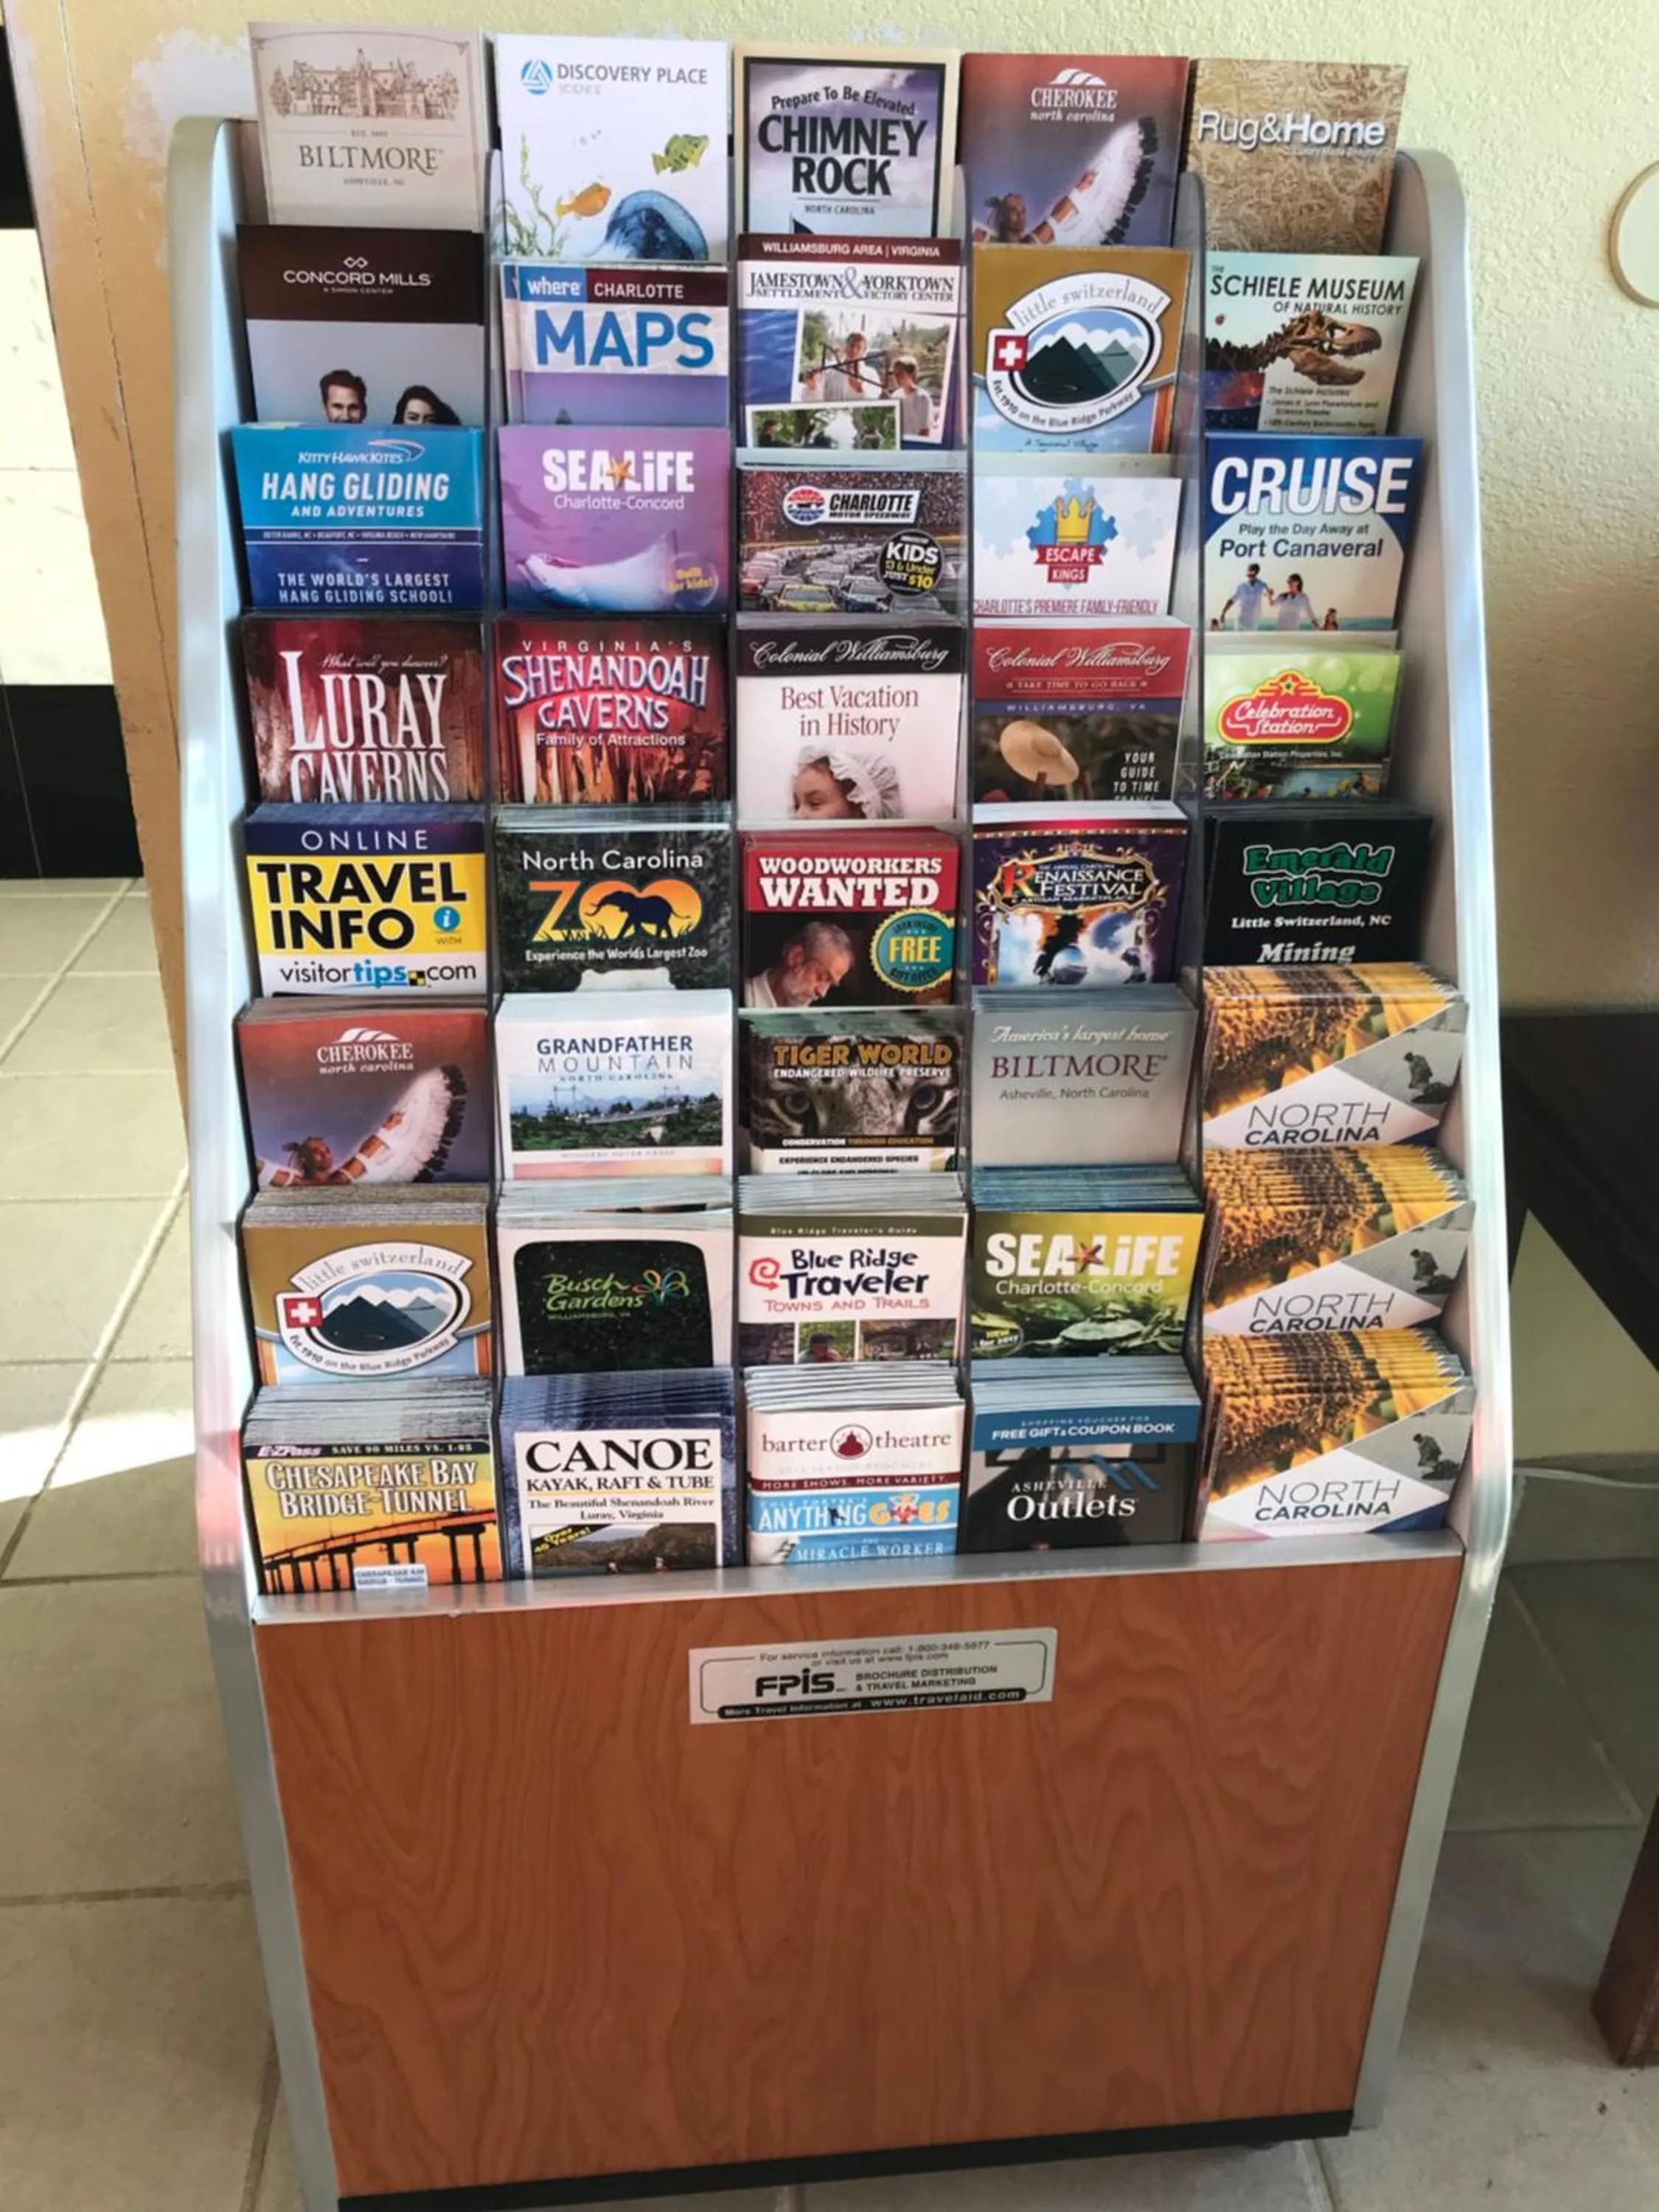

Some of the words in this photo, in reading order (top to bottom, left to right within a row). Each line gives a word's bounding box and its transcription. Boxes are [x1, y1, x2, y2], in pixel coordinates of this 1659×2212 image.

[557, 63, 651, 81] DISCOVERY
[657, 66, 708, 84] PLACE
[771, 91, 820, 110] Prepare
[823, 86, 838, 100] To
[843, 87, 860, 101] Be
[863, 90, 916, 115] Elevated
[1031, 88, 1118, 108] CHEROKEE
[758, 114, 928, 157] CHIMNEY
[299, 145, 439, 175] BILTMORE
[792, 156, 891, 195] ROCK
[762, 242, 849, 255] WILLIAMSBURG
[852, 243, 883, 256] AREA
[891, 245, 941, 257] VIRGINIA
[283, 270, 375, 285] CONCORD
[379, 272, 431, 286] MILLS
[526, 276, 580, 295] where
[594, 282, 684, 298] CHARLOTTE
[1210, 274, 1302, 298] SCHIELE
[1307, 278, 1405, 301] MUSEUM
[1273, 301, 1291, 313] OF
[1294, 302, 1348, 314] NATURAL
[1352, 304, 1405, 316] HISTORY
[535, 308, 714, 369] MAPS
[262, 472, 335, 501] HANG
[343, 472, 450, 501] GLIDING
[1211, 456, 1413, 515] CRUISE
[291, 505, 321, 517] AND
[326, 505, 425, 517] ADVENTURES
[830, 493, 914, 511] CHARLOTTE
[1238, 524, 1264, 536] Play
[1268, 524, 1289, 535] the
[1293, 524, 1317, 537] Day
[1319, 524, 1352, 537] Away
[1356, 524, 1369, 535] at
[886, 542, 939, 565] KIDS
[1045, 547, 1096, 563] ESCAPE
[1220, 539, 1267, 557] Port
[1272, 538, 1383, 557] Canaveral
[278, 573, 305, 586] THE
[310, 573, 379, 587] WORLD'S
[384, 574, 450, 587] LARGEST
[1052, 568, 1086, 581] KINGS
[279, 590, 319, 603] HANG
[325, 590, 384, 603] GLIDING
[390, 590, 453, 603] SCHOOL!
[502, 655, 709, 706] SHENANDOAH
[279, 651, 448, 751] LURAY
[782, 686, 824, 709] Best
[830, 685, 919, 708] Vacation
[538, 693, 669, 729] CAVERNS
[1234, 700, 1335, 720] Celebration
[799, 714, 820, 737] in
[828, 713, 900, 742] History
[537, 733, 584, 747] Family
[589, 734, 603, 745] of
[607, 734, 686, 745] Attractions
[1124, 751, 1155, 764] YOUR
[1120, 767, 1155, 778] GUIDE
[1113, 781, 1128, 792] TO
[1132, 781, 1160, 793] TIME
[301, 830, 429, 850] ONLINE
[523, 849, 594, 871] North
[602, 849, 703, 869] Carolina
[759, 858, 942, 874] WOODWORKERS
[1243, 842, 1395, 877] Emerald
[256, 862, 467, 903] TRAVEL
[759, 877, 940, 907] WANTED
[1040, 883, 1141, 897] FESTIVAL
[1251, 875, 1382, 908] Village
[271, 908, 414, 950] INFO
[1231, 917, 1270, 929] Little
[1274, 915, 1365, 928] Switzerland,
[1368, 915, 1392, 926] NC
[435, 936, 462, 945] WITH
[888, 936, 942, 964] FREE
[525, 950, 585, 963] Experience
[588, 949, 605, 959] the
[647, 947, 686, 961] Largest
[688, 946, 708, 958] Zoo
[1256, 942, 1356, 963] Mining
[316, 1043, 414, 1063] CHEROKEE
[537, 1035, 693, 1054] GRANDFATHER
[773, 1044, 849, 1066] TIGER
[858, 1043, 953, 1066] WORLD
[319, 1062, 356, 1074] north
[360, 1061, 414, 1073] carolina
[538, 1054, 693, 1074] MOUNTAIN
[774, 1068, 844, 1078] ENDANGERED
[849, 1068, 894, 1078] WILDLIFE
[899, 1068, 951, 1077] PRESERVE
[991, 1054, 1162, 1082] BILTMORE
[999, 1089, 1056, 1100] Asheville,
[1060, 1088, 1096, 1099] North
[1099, 1087, 1150, 1099] Carolina
[1248, 1102, 1391, 1130] NORTH
[1245, 1127, 1380, 1145] CAROLINA
[830, 1155, 883, 1164] ENDANGERED
[886, 1155, 919, 1163] SPECIES
[797, 1227, 827, 1236] Ridge
[832, 1226, 883, 1234] Traveler's
[888, 1226, 917, 1234] Guide
[790, 1248, 844, 1270] Blue
[849, 1248, 919, 1270] Ridge
[543, 1273, 631, 1294] Busch
[779, 1269, 930, 1299] Traveler
[546, 1291, 646, 1312] Gardens
[763, 1299, 823, 1313] TOWNS
[831, 1299, 866, 1310] AND
[872, 1296, 930, 1310] TRAILS
[1253, 1292, 1396, 1318] NORTH
[1248, 1315, 1384, 1334] CAROLINA
[762, 1433, 828, 1453] barter
[875, 1430, 952, 1450] theatre
[992, 1429, 1026, 1441] FREE
[1029, 1427, 1060, 1438] GIFT
[1068, 1425, 1131, 1436] COUPON
[1133, 1423, 1175, 1434] BOOK
[526, 1439, 714, 1472] CANOE
[266, 1461, 425, 1491] CHESAPEAKE
[430, 1458, 477, 1485] BAY
[527, 1478, 592, 1492] KAYAK,
[597, 1476, 641, 1490] RAFT
[647, 1477, 663, 1489] &
[666, 1475, 714, 1489] TUBE
[1011, 1479, 1107, 1493] ASHEVILLE
[1258, 1479, 1401, 1506] NORTH
[528, 1499, 552, 1509] The
[554, 1498, 607, 1508] Beautiful
[611, 1497, 680, 1507] Shenandoah
[684, 1497, 714, 1507] River
[1006, 1491, 1136, 1522] Outlets
[1254, 1501, 1391, 1520] CAROLINA
[580, 1511, 615, 1520] Luray,
[619, 1510, 664, 1520] Virginia
[796, 1546, 869, 1561] MIRACLE
[877, 1543, 944, 1556] WORKER
[855, 1669, 918, 1682] BROCHURE
[921, 1665, 998, 1677] DISTRIBUTION
[866, 1680, 908, 1691] TRAVEL
[911, 1677, 976, 1689] MARKETING
[724, 1707, 751, 1716] More
[755, 1705, 788, 1714] Travel
[790, 1703, 848, 1713] Information
[870, 1690, 1020, 1708] www.travelaid.com
